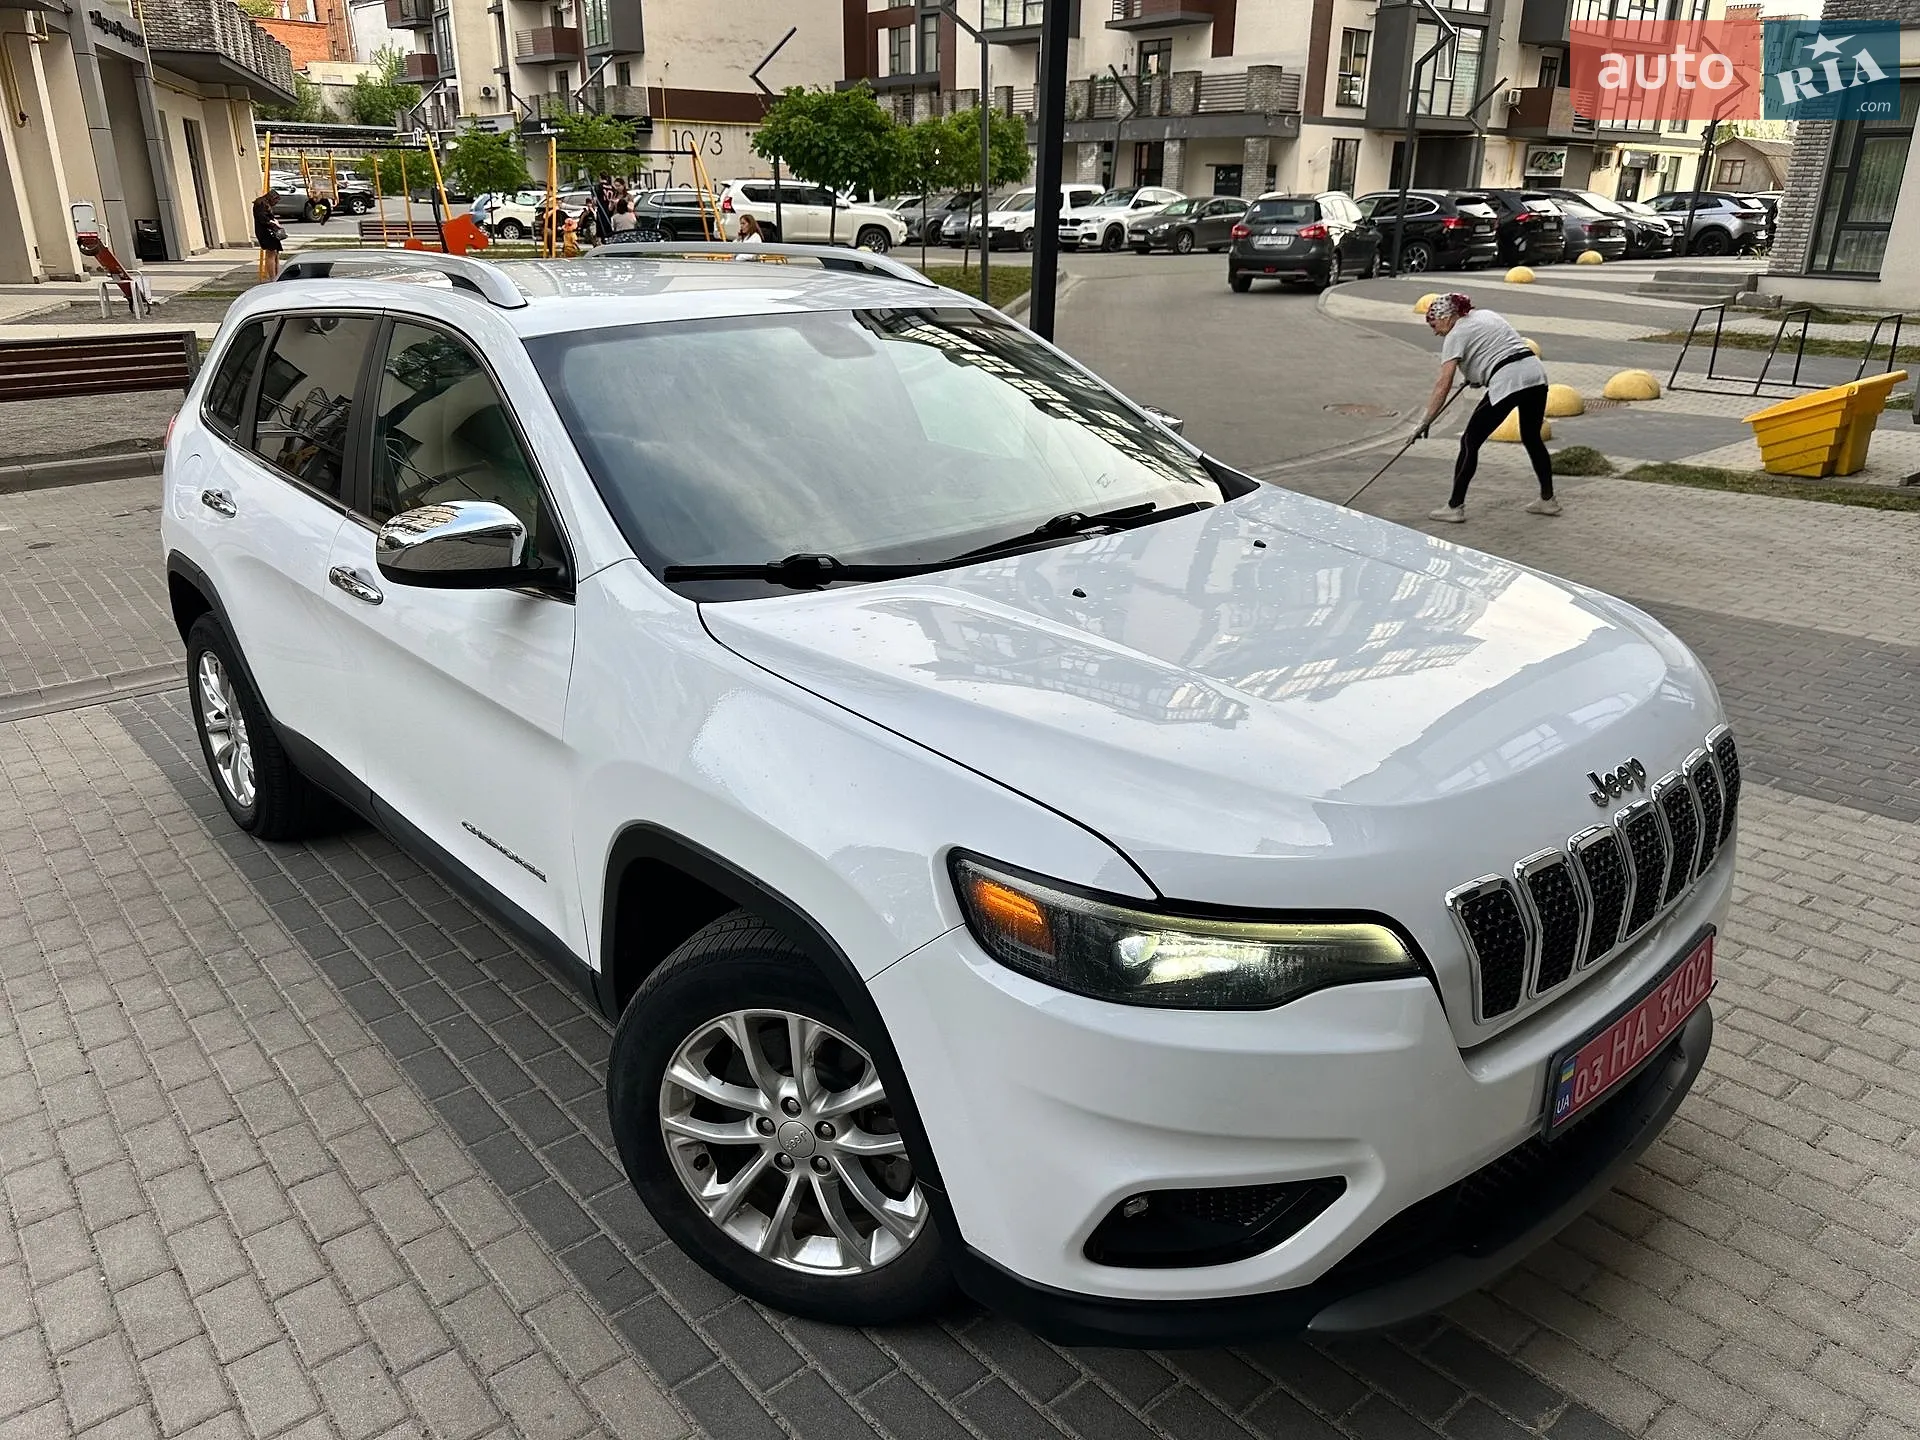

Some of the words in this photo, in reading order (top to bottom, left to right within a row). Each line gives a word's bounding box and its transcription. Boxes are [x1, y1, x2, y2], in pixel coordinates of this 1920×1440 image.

[672, 129, 723, 155] 10/3
[1586, 757, 1647, 807] Jeep
[1574, 1054, 1604, 1103] 03
[1611, 1007, 1649, 1077] HA
[1656, 950, 1708, 1034] 3402
[1556, 1094, 1571, 1114] UA
